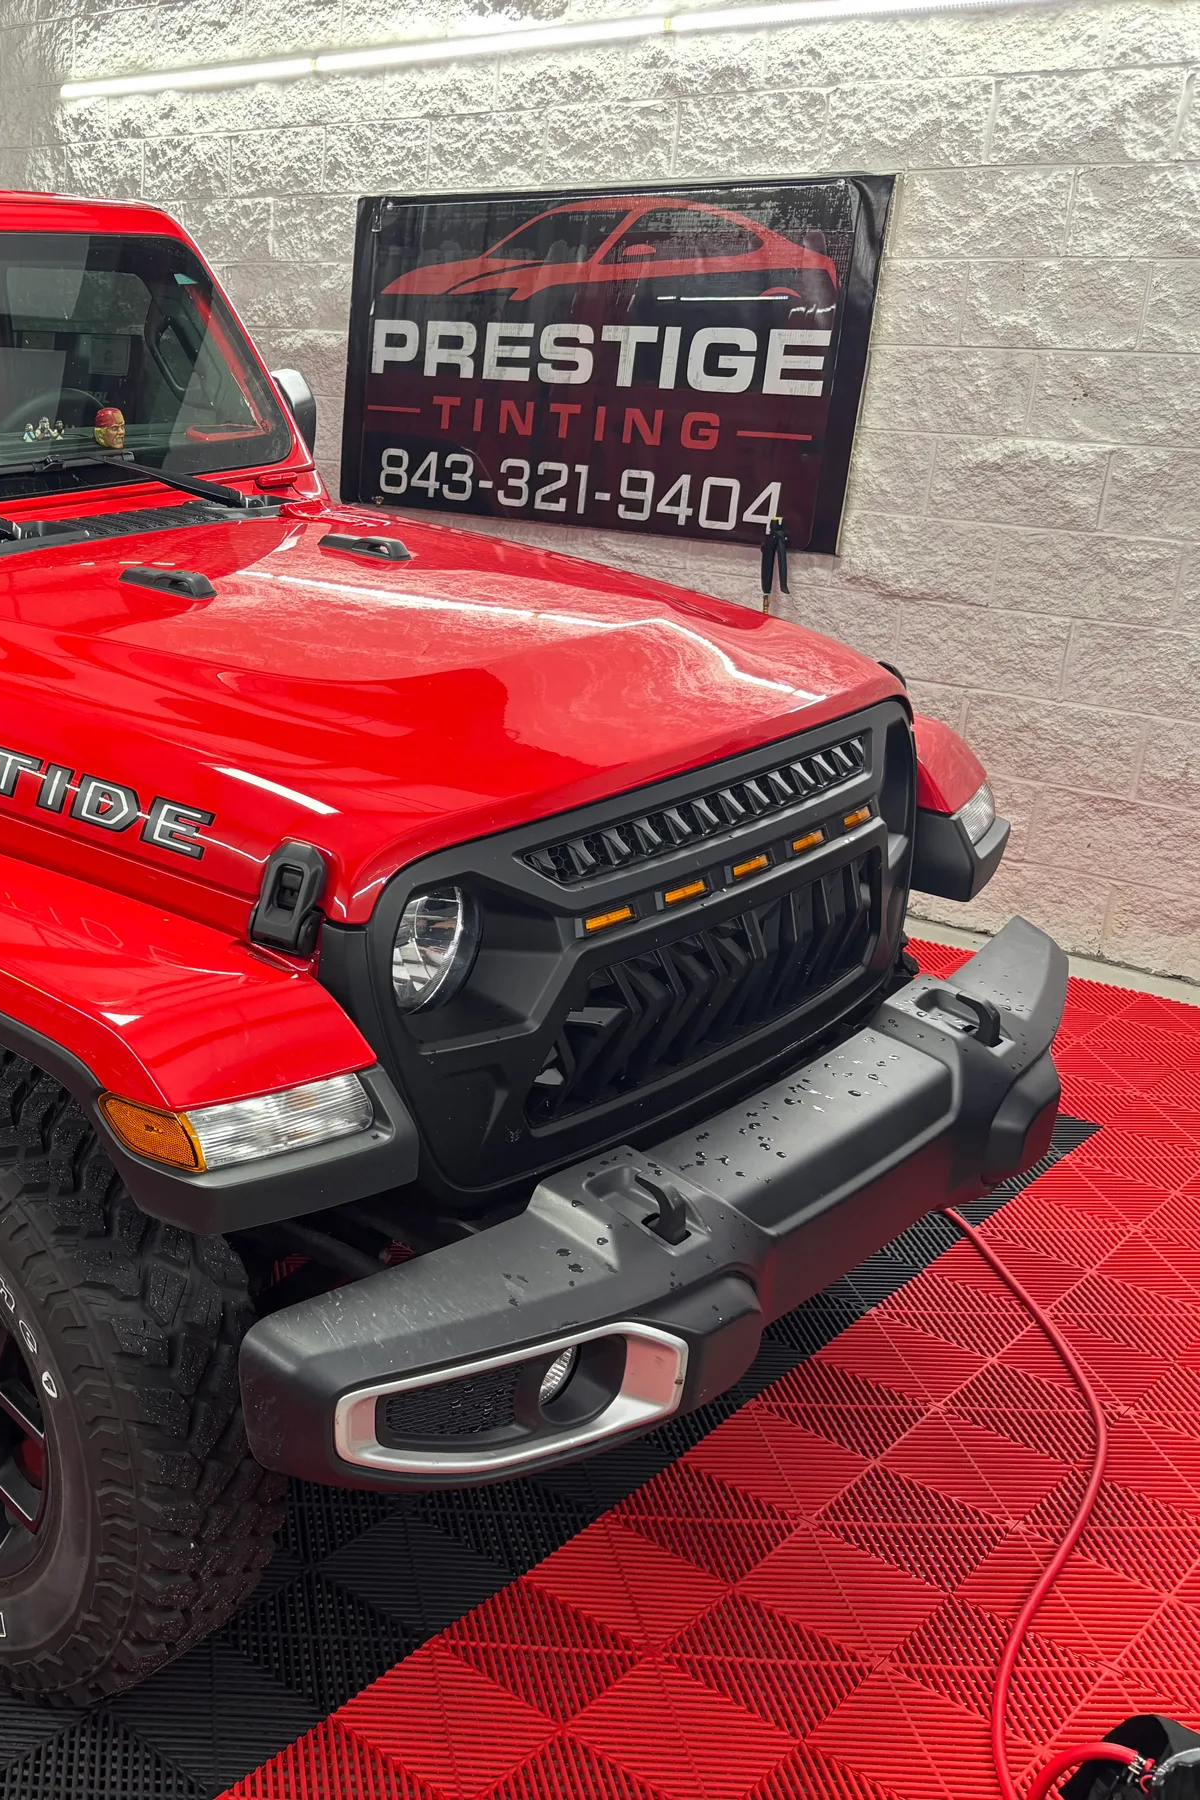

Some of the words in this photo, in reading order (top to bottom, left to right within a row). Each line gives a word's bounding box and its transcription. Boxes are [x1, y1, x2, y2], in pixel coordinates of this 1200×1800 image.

[370, 319, 832, 396] PRESTIGE
[432, 396, 721, 450] TINTING
[379, 447, 782, 536] 843-321-9404
